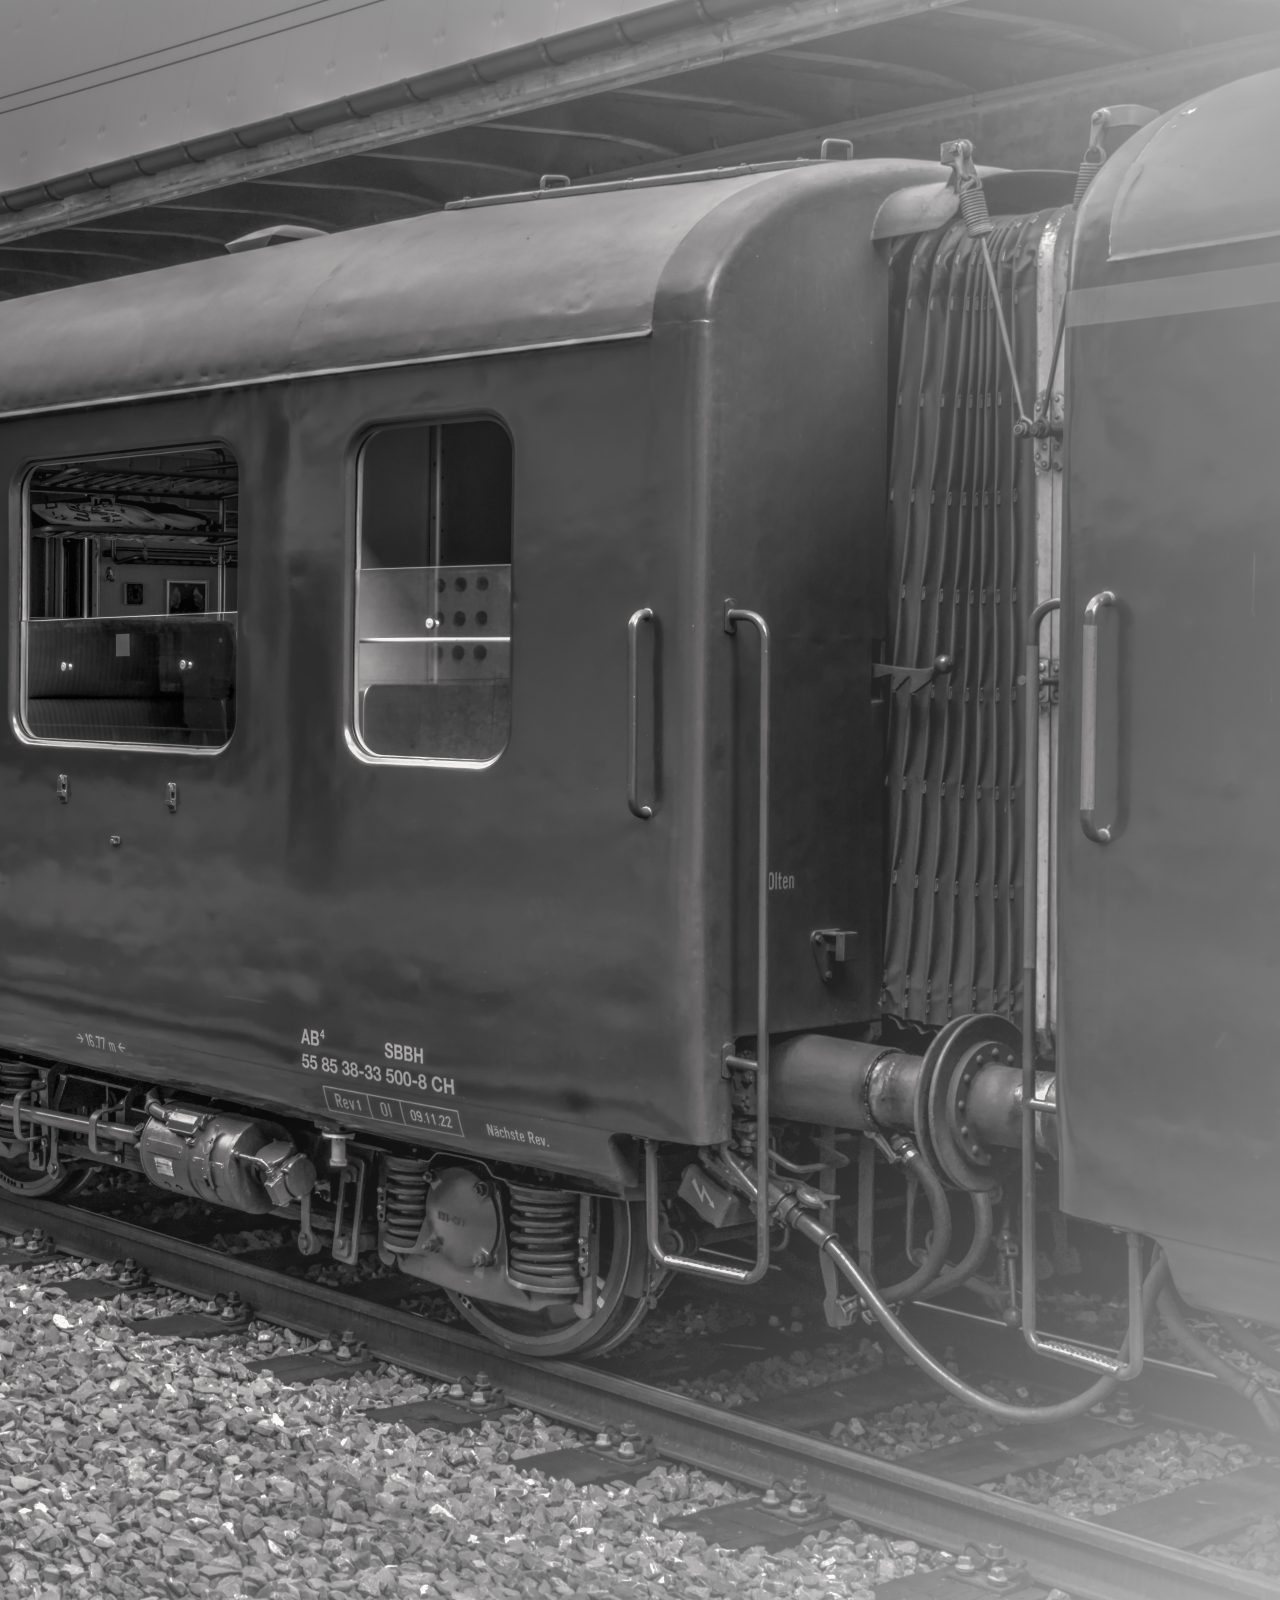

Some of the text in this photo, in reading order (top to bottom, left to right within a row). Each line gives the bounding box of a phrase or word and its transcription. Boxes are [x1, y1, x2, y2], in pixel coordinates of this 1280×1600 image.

[768, 871, 795, 890] Olten
[384, 1042, 424, 1065] SBBH
[301, 1053, 455, 1096] 55 85 38-33 500-8 CH
[409, 1109, 453, 1129] 09.11.22
[485, 1123, 551, 1148] Nächste Rev.
